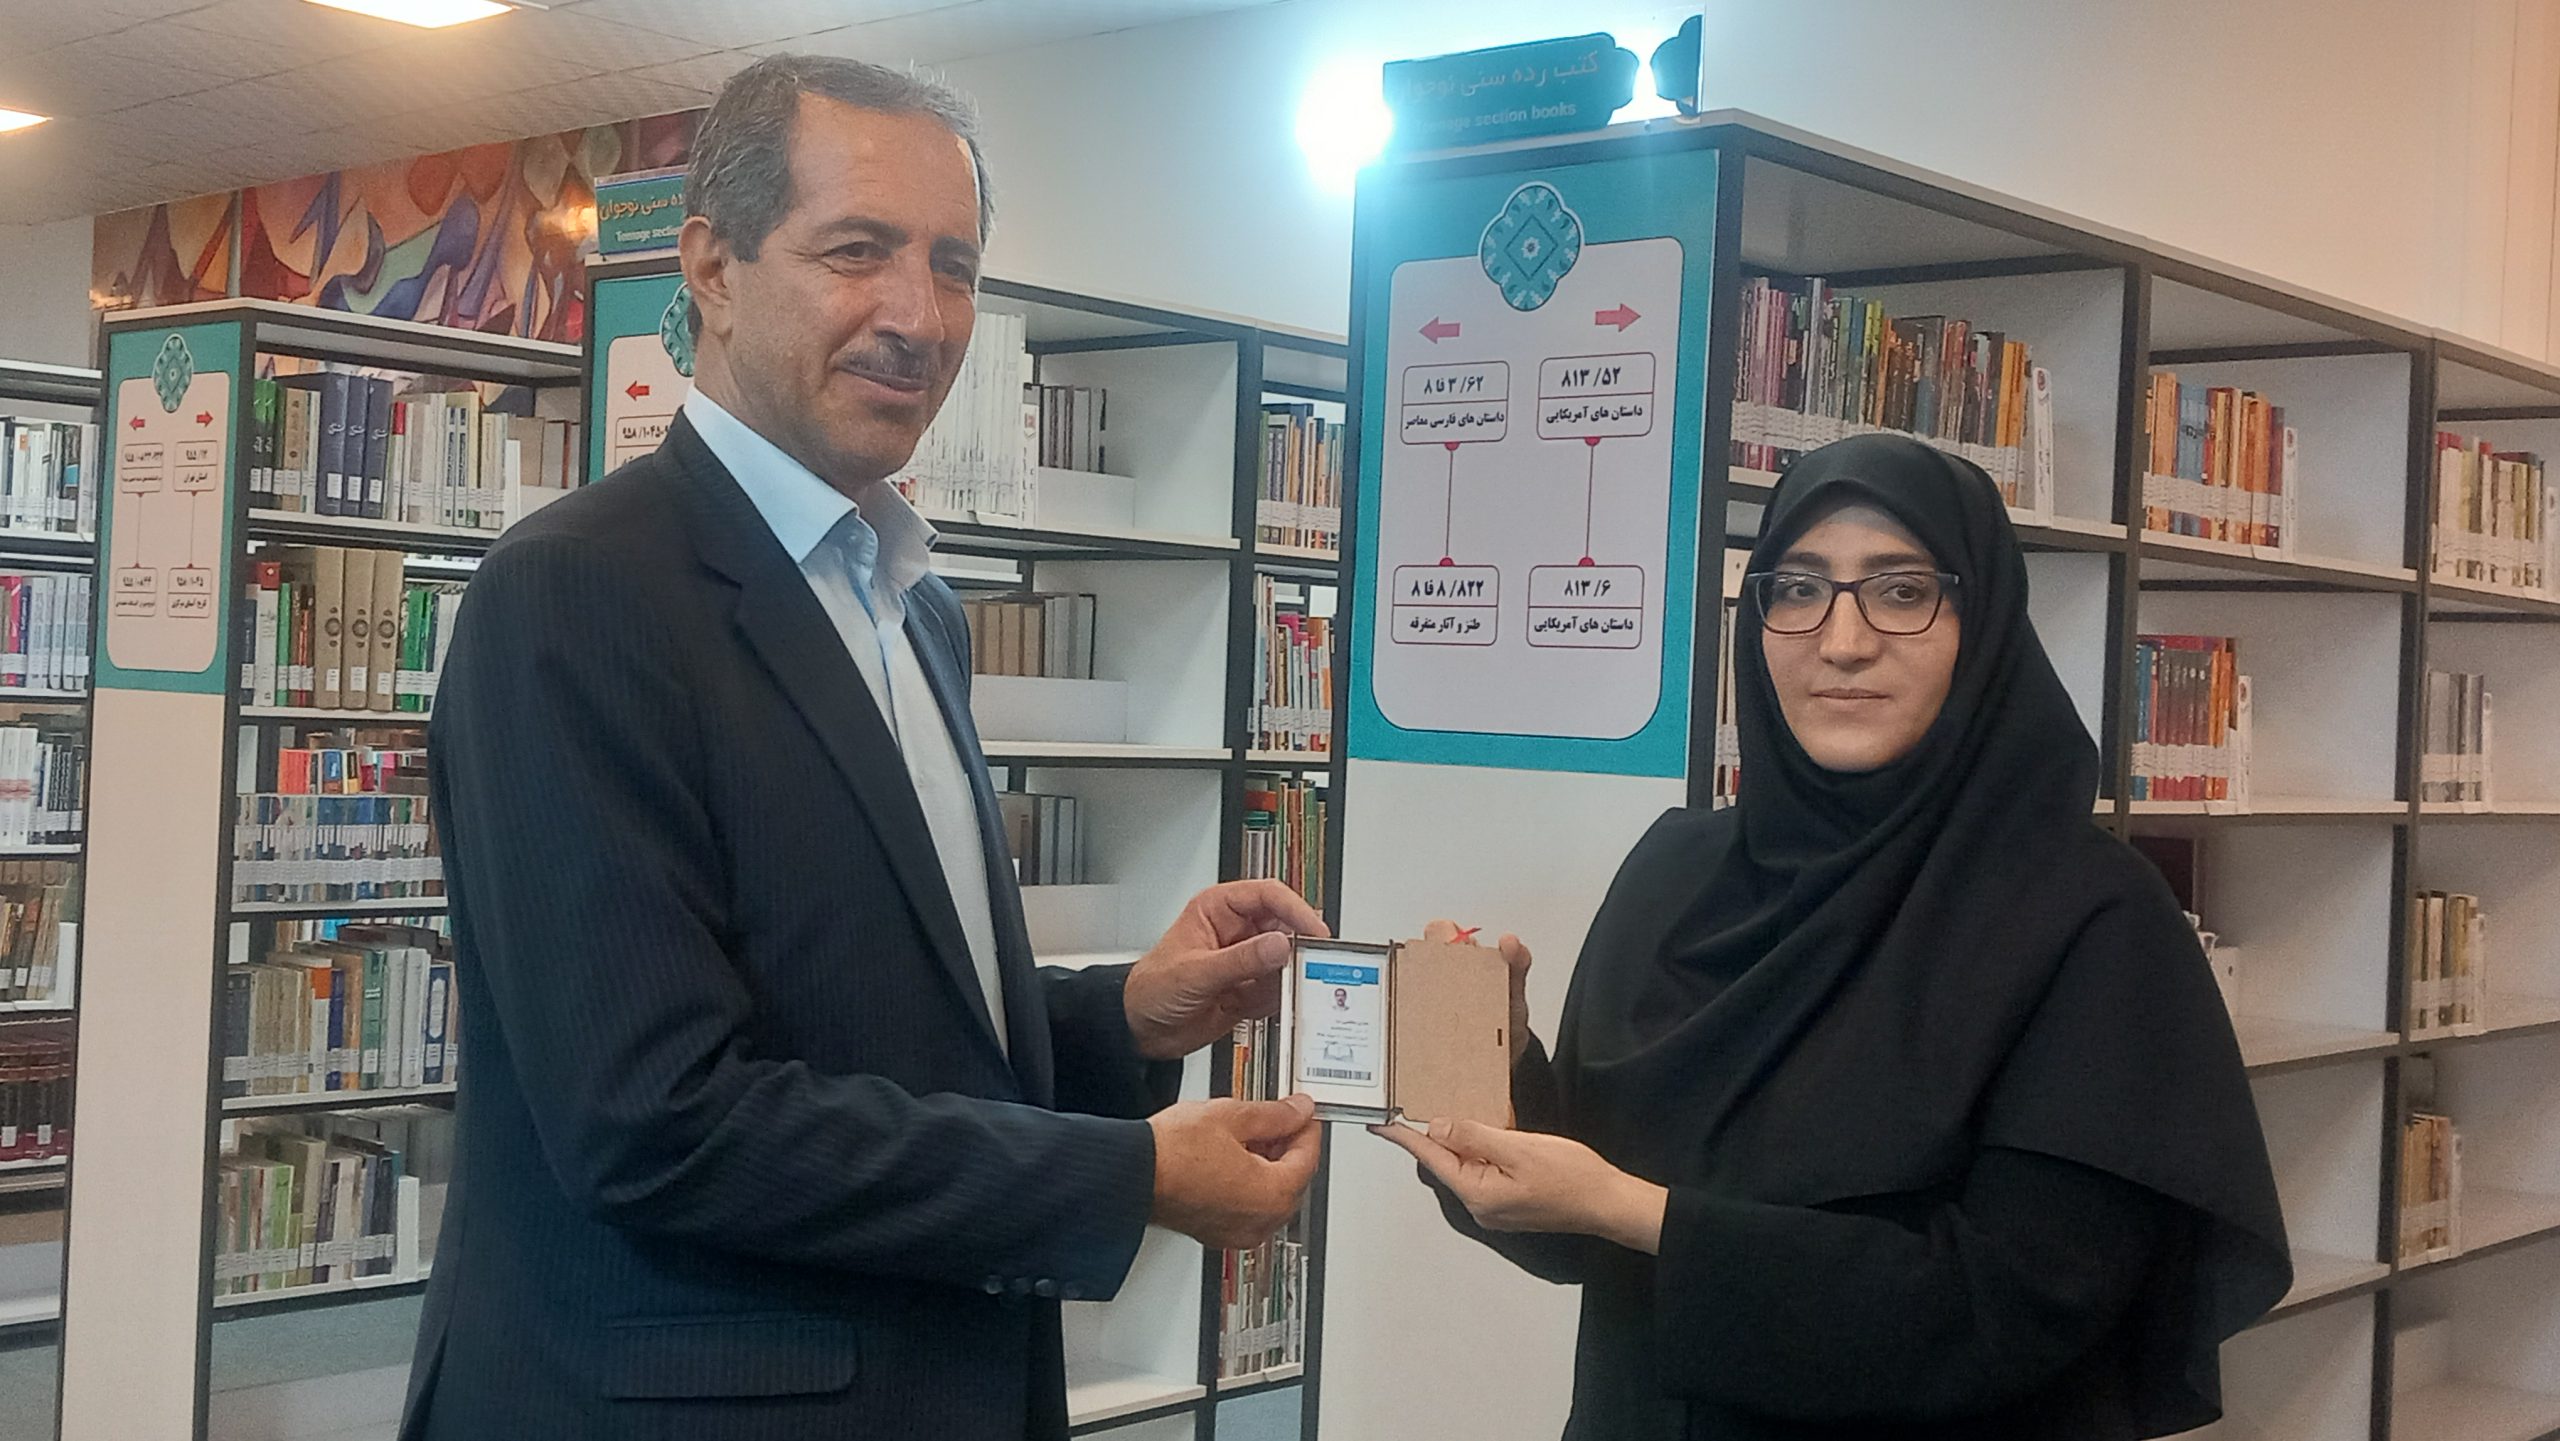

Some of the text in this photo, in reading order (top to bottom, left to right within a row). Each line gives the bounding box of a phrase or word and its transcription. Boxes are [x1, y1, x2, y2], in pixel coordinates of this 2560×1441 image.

[1512, 60, 1547, 88] رده
[1554, 50, 1599, 84] کتب
[1461, 71, 1506, 97] سنی
[1475, 109, 1527, 126] section
[1531, 100, 1577, 119] books
[598, 197, 640, 221] نوجوان
[641, 195, 669, 215] سنی
[1430, 413, 1456, 429] فارسی
[1457, 412, 1475, 427] های
[1477, 412, 1505, 424] داستان
[1545, 404, 1643, 424] داستان های آمریکایی
[1409, 616, 1481, 635] طنز و آثار متفرقه
[1534, 616, 1634, 634] داستان های آمریکایی
